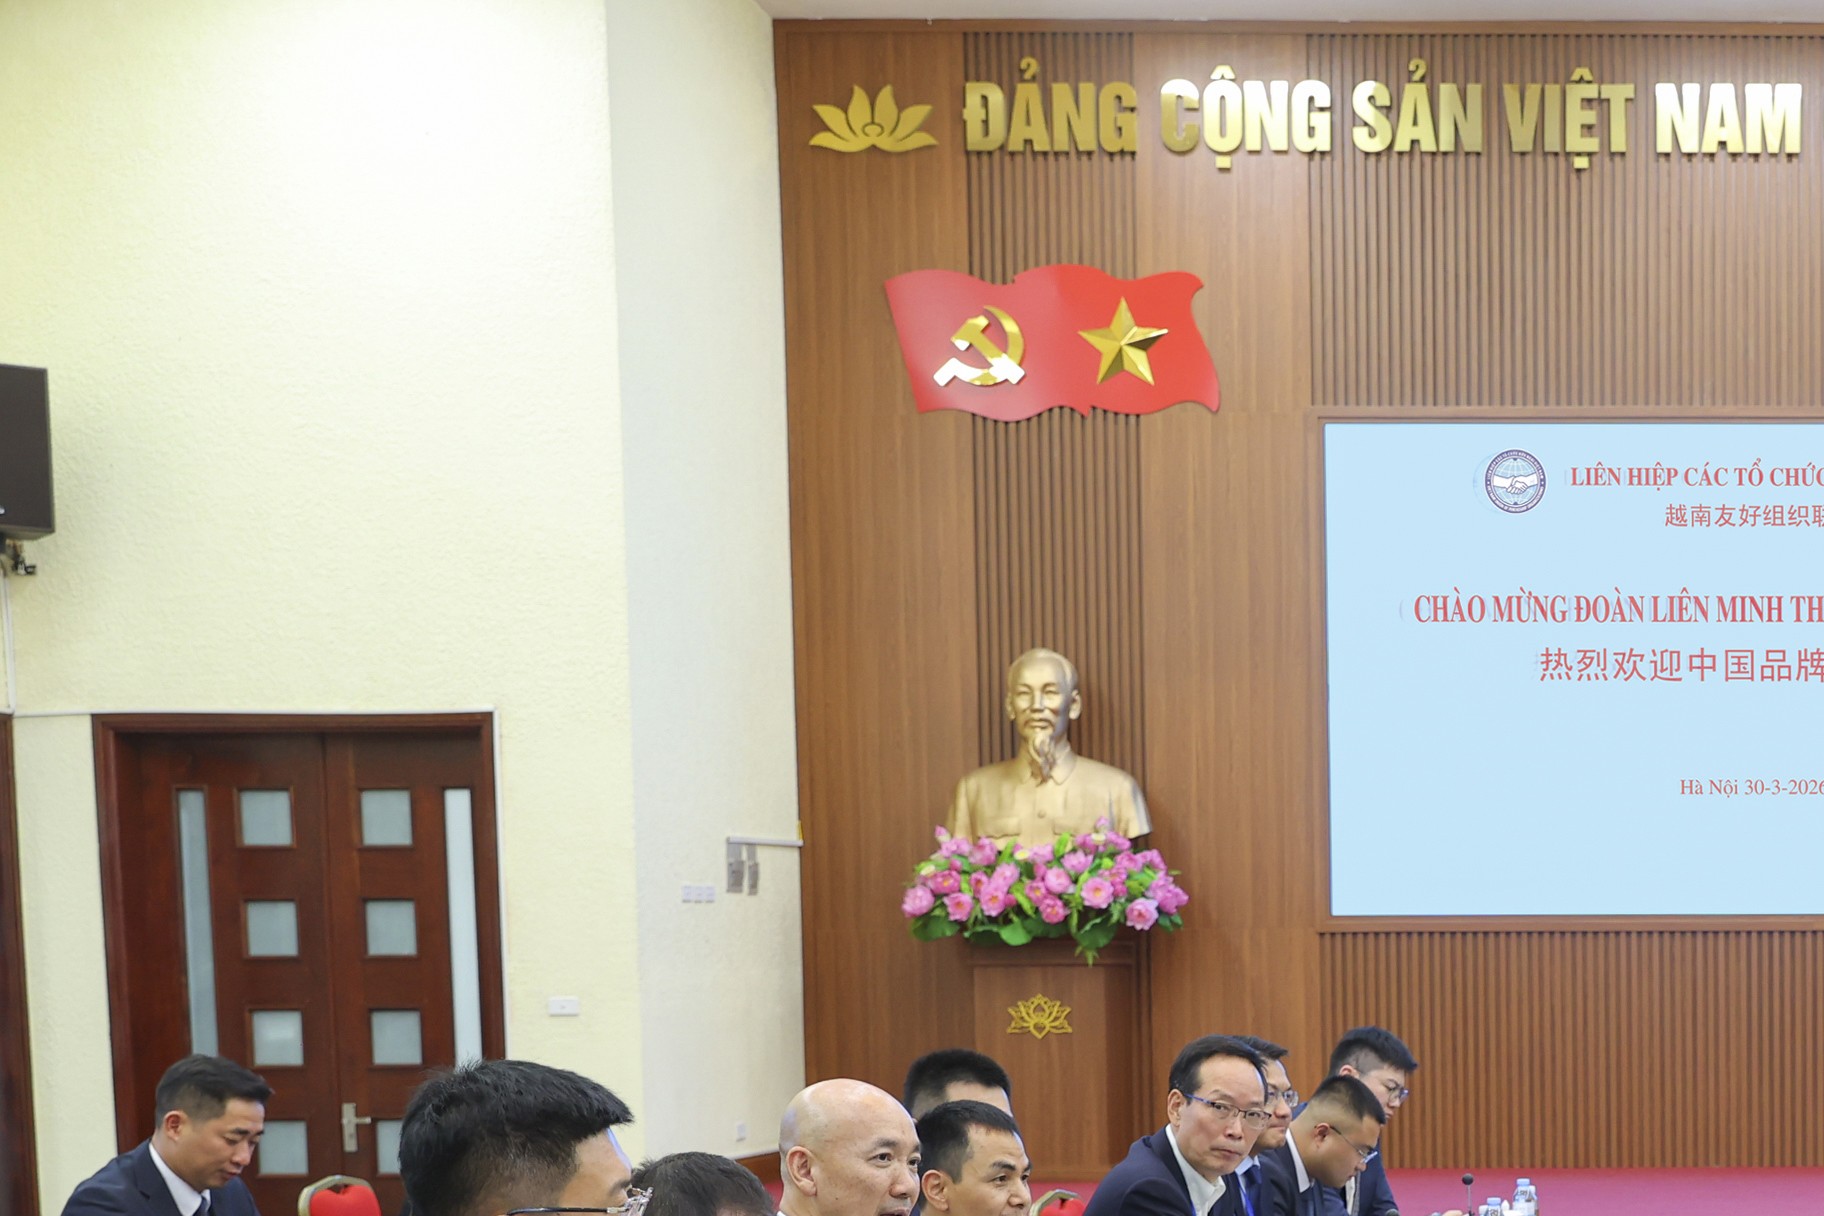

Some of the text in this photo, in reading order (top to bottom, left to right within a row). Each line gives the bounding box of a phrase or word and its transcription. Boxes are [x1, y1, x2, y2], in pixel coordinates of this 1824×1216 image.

[962, 55, 1138, 154] ĐẢNG
[1159, 64, 1333, 169] CỘNG
[1350, 57, 1484, 155] SẢN
[1502, 65, 1636, 169] VIỆT
[1654, 82, 1803, 155] NAM
[1571, 461, 1621, 487] LIÊN
[1627, 461, 1679, 492] HIỆP
[1683, 461, 1729, 487] CÁC
[1733, 457, 1765, 487] TỔ
[1413, 586, 1487, 623] CHÀO
[1492, 586, 1569, 623] MỪNG
[1574, 587, 1645, 623] ĐOÀN
[1651, 586, 1710, 623] LIÊN
[1716, 595, 1784, 623] MINH
[1680, 778, 1704, 795] Hà
[1708, 779, 1739, 798] Nội
